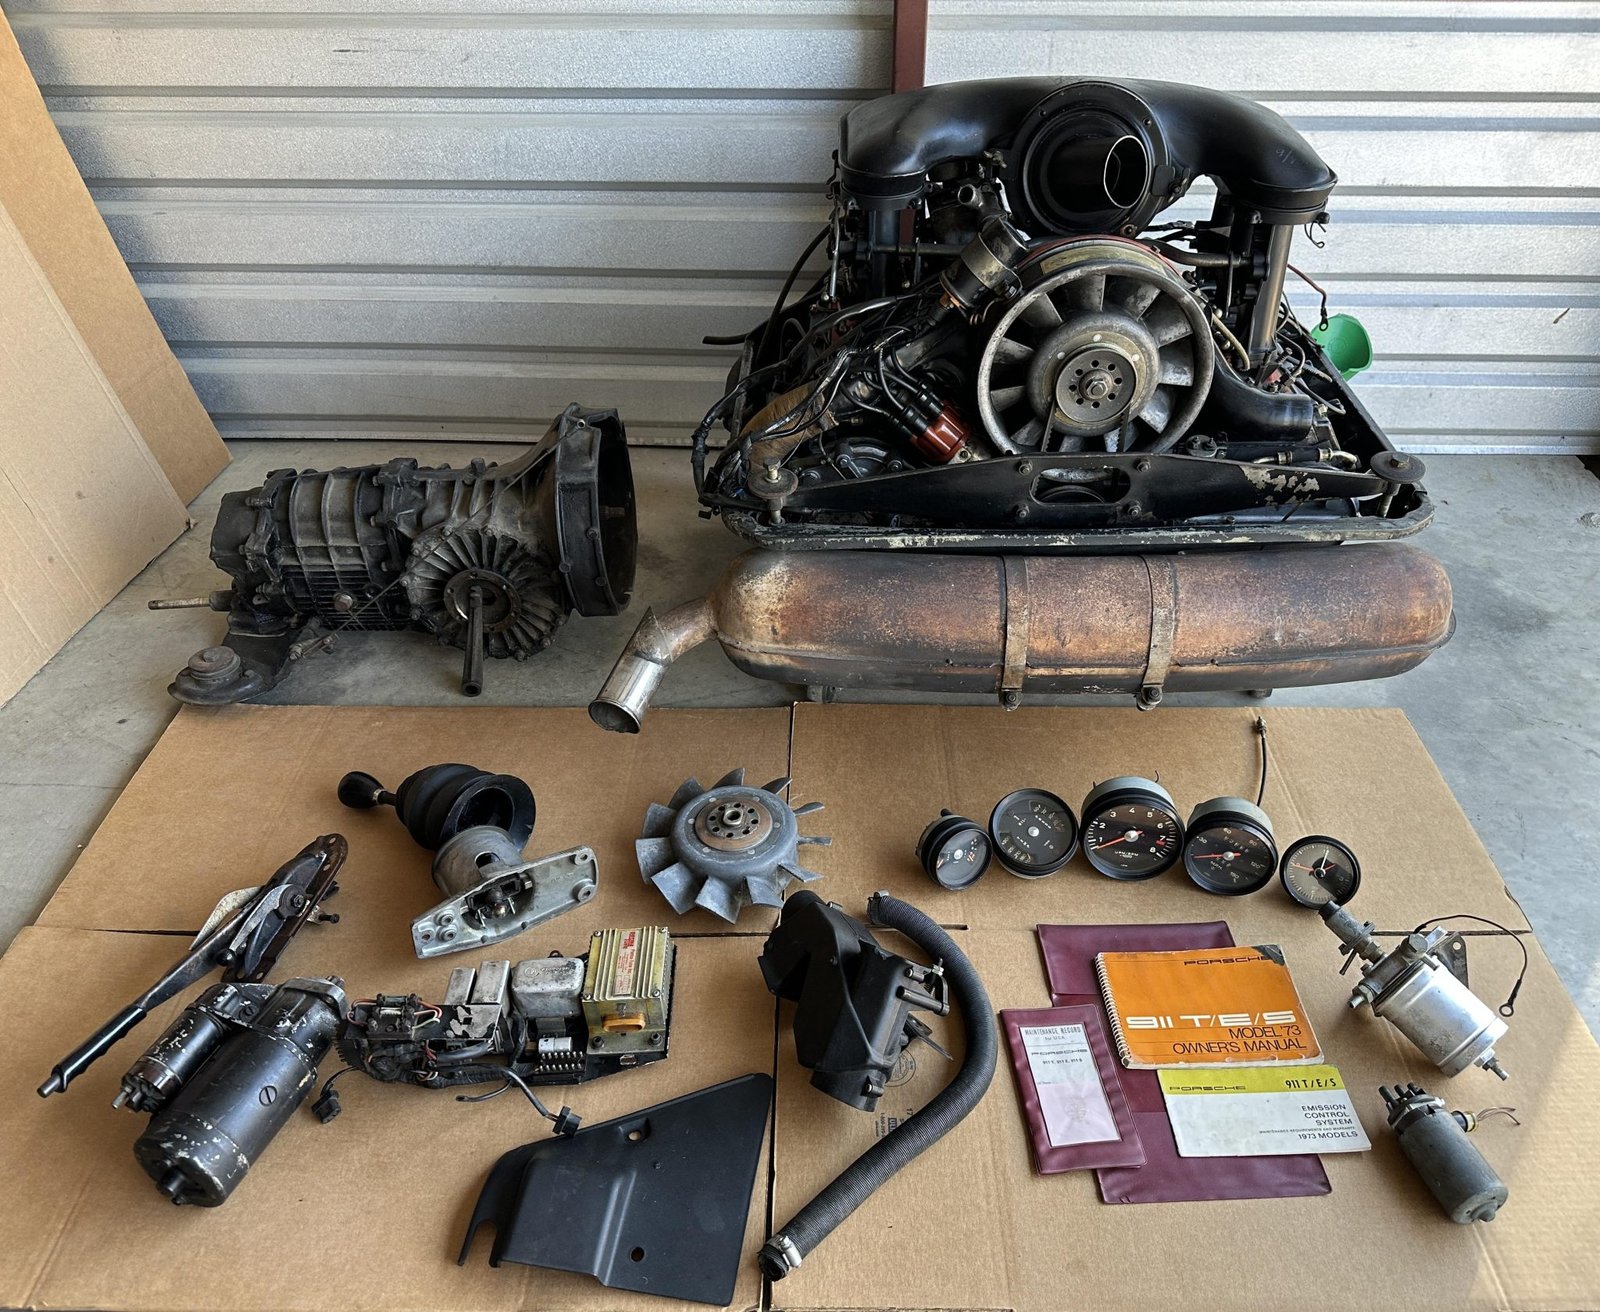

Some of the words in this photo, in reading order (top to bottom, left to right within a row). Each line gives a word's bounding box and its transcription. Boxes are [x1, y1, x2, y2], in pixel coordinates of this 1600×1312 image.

[1126, 1015, 1174, 1029] 911
[1179, 1010, 1296, 1028] T/E/S
[1172, 1041, 1241, 1055] OWNER'S
[1243, 1038, 1307, 1052] MANUAL
[1285, 1079, 1301, 1089] 911
[1301, 1103, 1347, 1112] EMISSION
[1304, 1110, 1350, 1119] CONTROL
[1315, 1118, 1353, 1126] SYSTEM
[1318, 1130, 1359, 1139] MODELS
